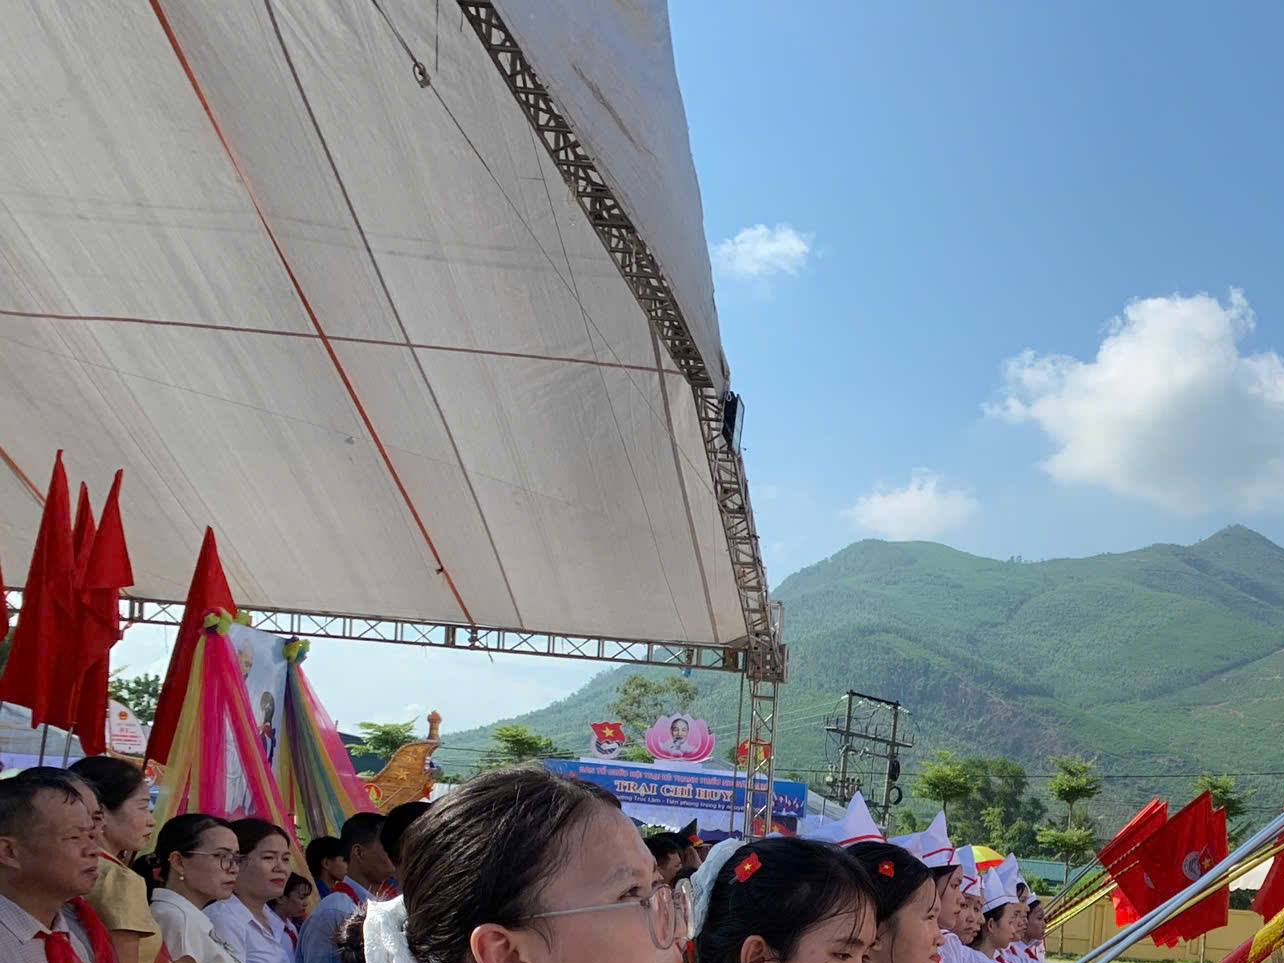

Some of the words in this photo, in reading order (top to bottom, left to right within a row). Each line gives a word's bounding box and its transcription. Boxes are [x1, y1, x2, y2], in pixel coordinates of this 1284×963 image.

[614, 779, 658, 797] TRẠI
[660, 784, 693, 798] CHÍ
[695, 788, 734, 801] HUY
